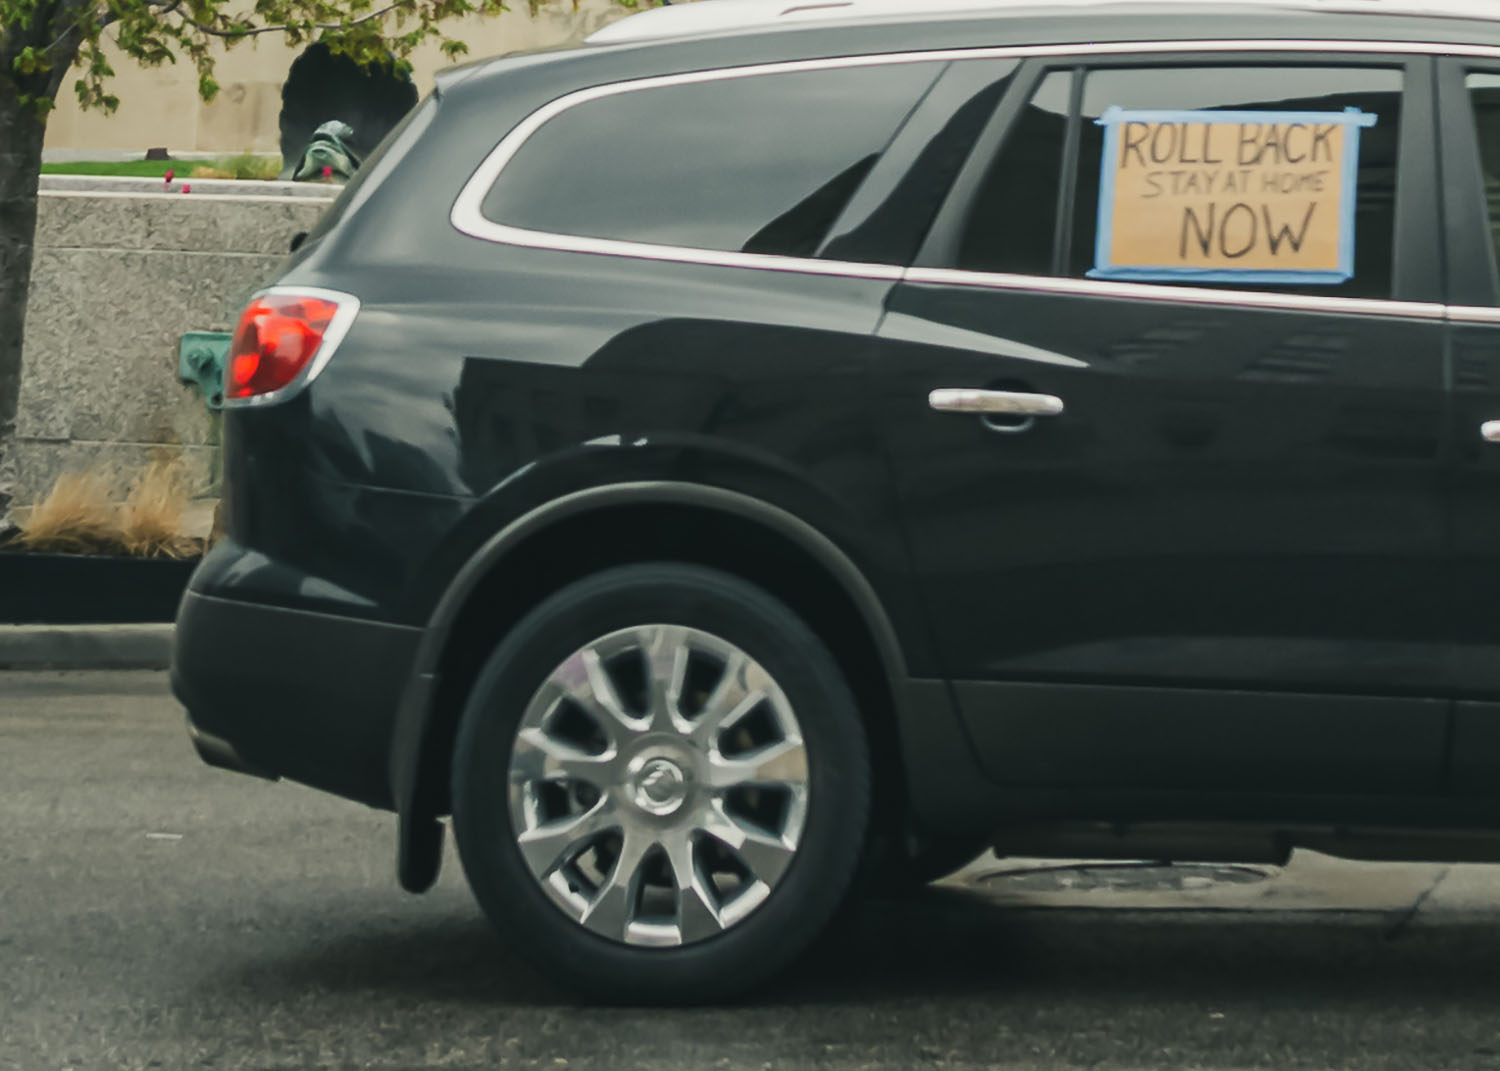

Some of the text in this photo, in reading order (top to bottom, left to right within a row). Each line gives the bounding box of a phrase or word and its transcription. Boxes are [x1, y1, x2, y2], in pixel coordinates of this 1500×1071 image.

[1119, 120, 1337, 168] ROLL BACK
[1141, 170, 1331, 198] STAY AT HOME
[1179, 201, 1317, 260] NOW
